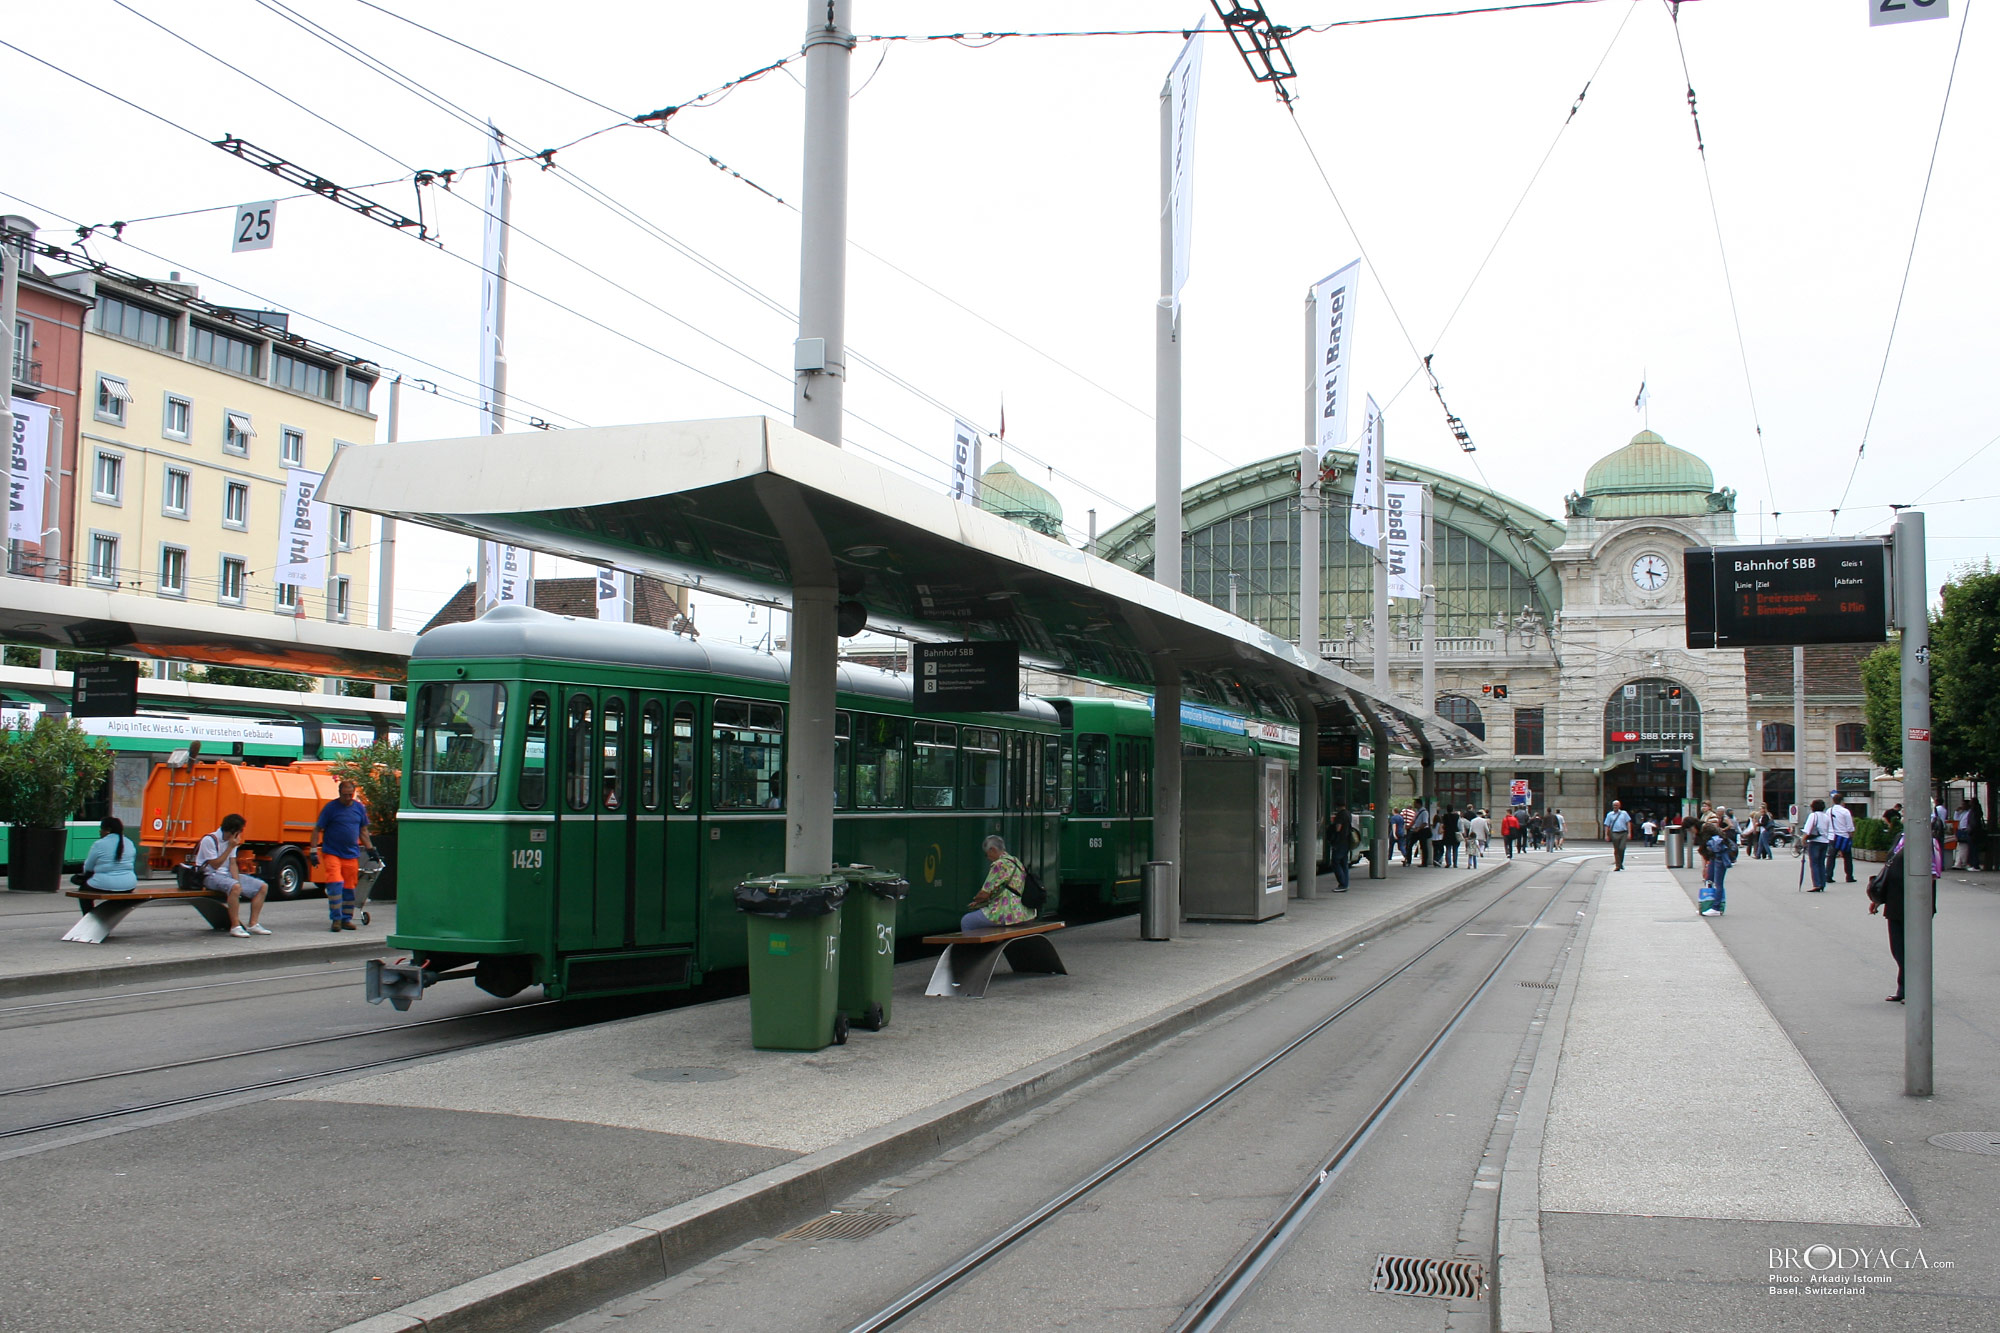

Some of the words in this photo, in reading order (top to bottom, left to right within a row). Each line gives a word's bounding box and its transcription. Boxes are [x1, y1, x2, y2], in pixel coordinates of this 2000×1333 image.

[239, 209, 271, 243] 25
[1734, 559, 1789, 572] Bahnhof
[1792, 558, 1816, 569] SBB
[1743, 594, 1749, 603] 1
[1742, 606, 1749, 616] 2
[1757, 604, 1806, 616] Binningen
[1840, 602, 1847, 612] 6
[1848, 602, 1865, 612] Min
[923, 648, 957, 657] Bahnhof
[959, 648, 974, 656] SBB
[927, 664, 934, 673] 2
[927, 682, 934, 690] 8
[1626, 687, 1634, 695] 18
[453, 690, 470, 723] 2
[108, 721, 130, 732] Alpiq
[131, 722, 151, 732] InTec
[152, 724, 173, 733] West
[173, 725, 184, 734] AG
[191, 726, 204, 735] Wir
[206, 728, 242, 737] verstehen
[243, 729, 273, 739] Gebäude
[1641, 732, 1658, 740] SBB
[1661, 732, 1677, 740] CFF
[1679, 732, 1694, 740] FFS
[331, 732, 358, 746] ALPIQ
[1089, 837, 1103, 848] 663
[512, 849, 542, 868] 1429
